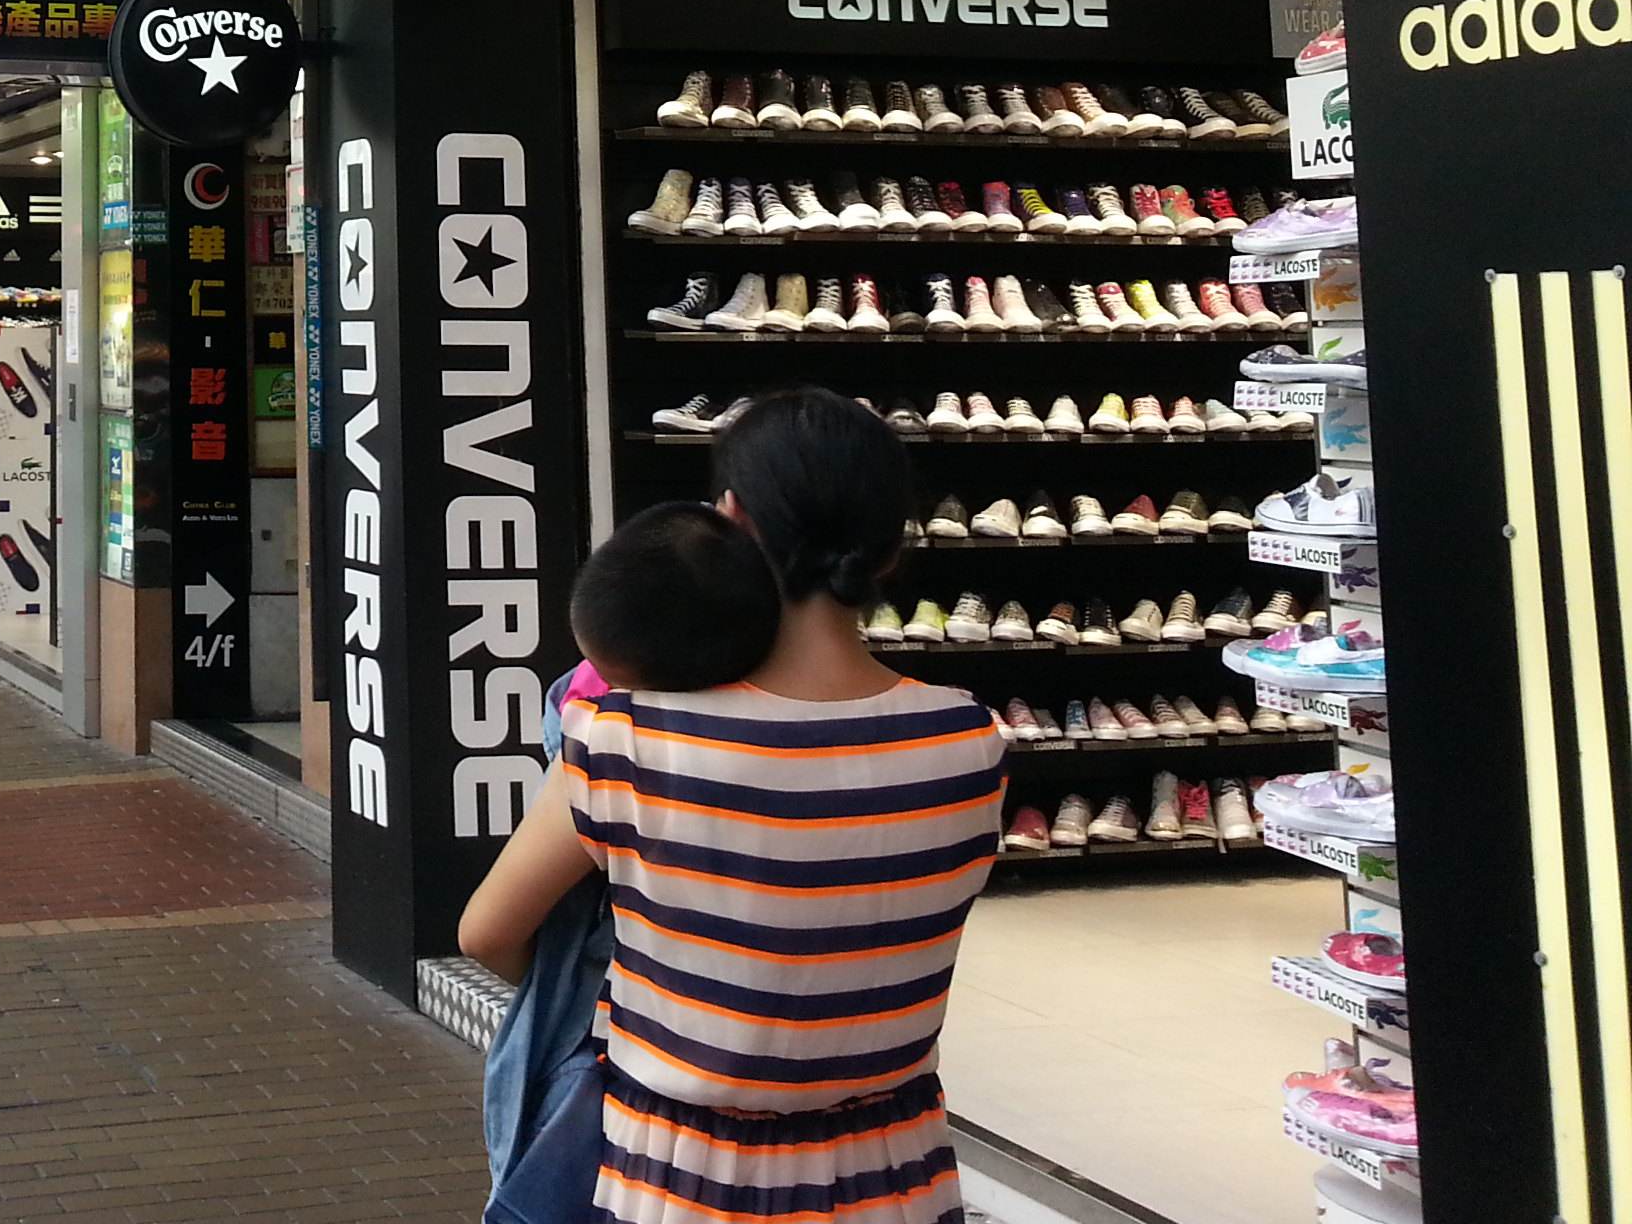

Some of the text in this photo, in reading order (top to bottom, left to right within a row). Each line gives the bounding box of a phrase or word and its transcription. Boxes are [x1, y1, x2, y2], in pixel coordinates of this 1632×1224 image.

[139, 6, 284, 63] Converse
[1274, 257, 1319, 276] LACOSTE
[1279, 389, 1325, 407] LACOSTE
[1294, 546, 1340, 568] LACOSTE
[184, 633, 235, 668] 4/f
[1301, 694, 1348, 721] LACOSTE
[1310, 838, 1357, 870] LACOSTE
[1316, 986, 1366, 1021] LACOSTE
[1329, 1142, 1380, 1182] LACOSTE
